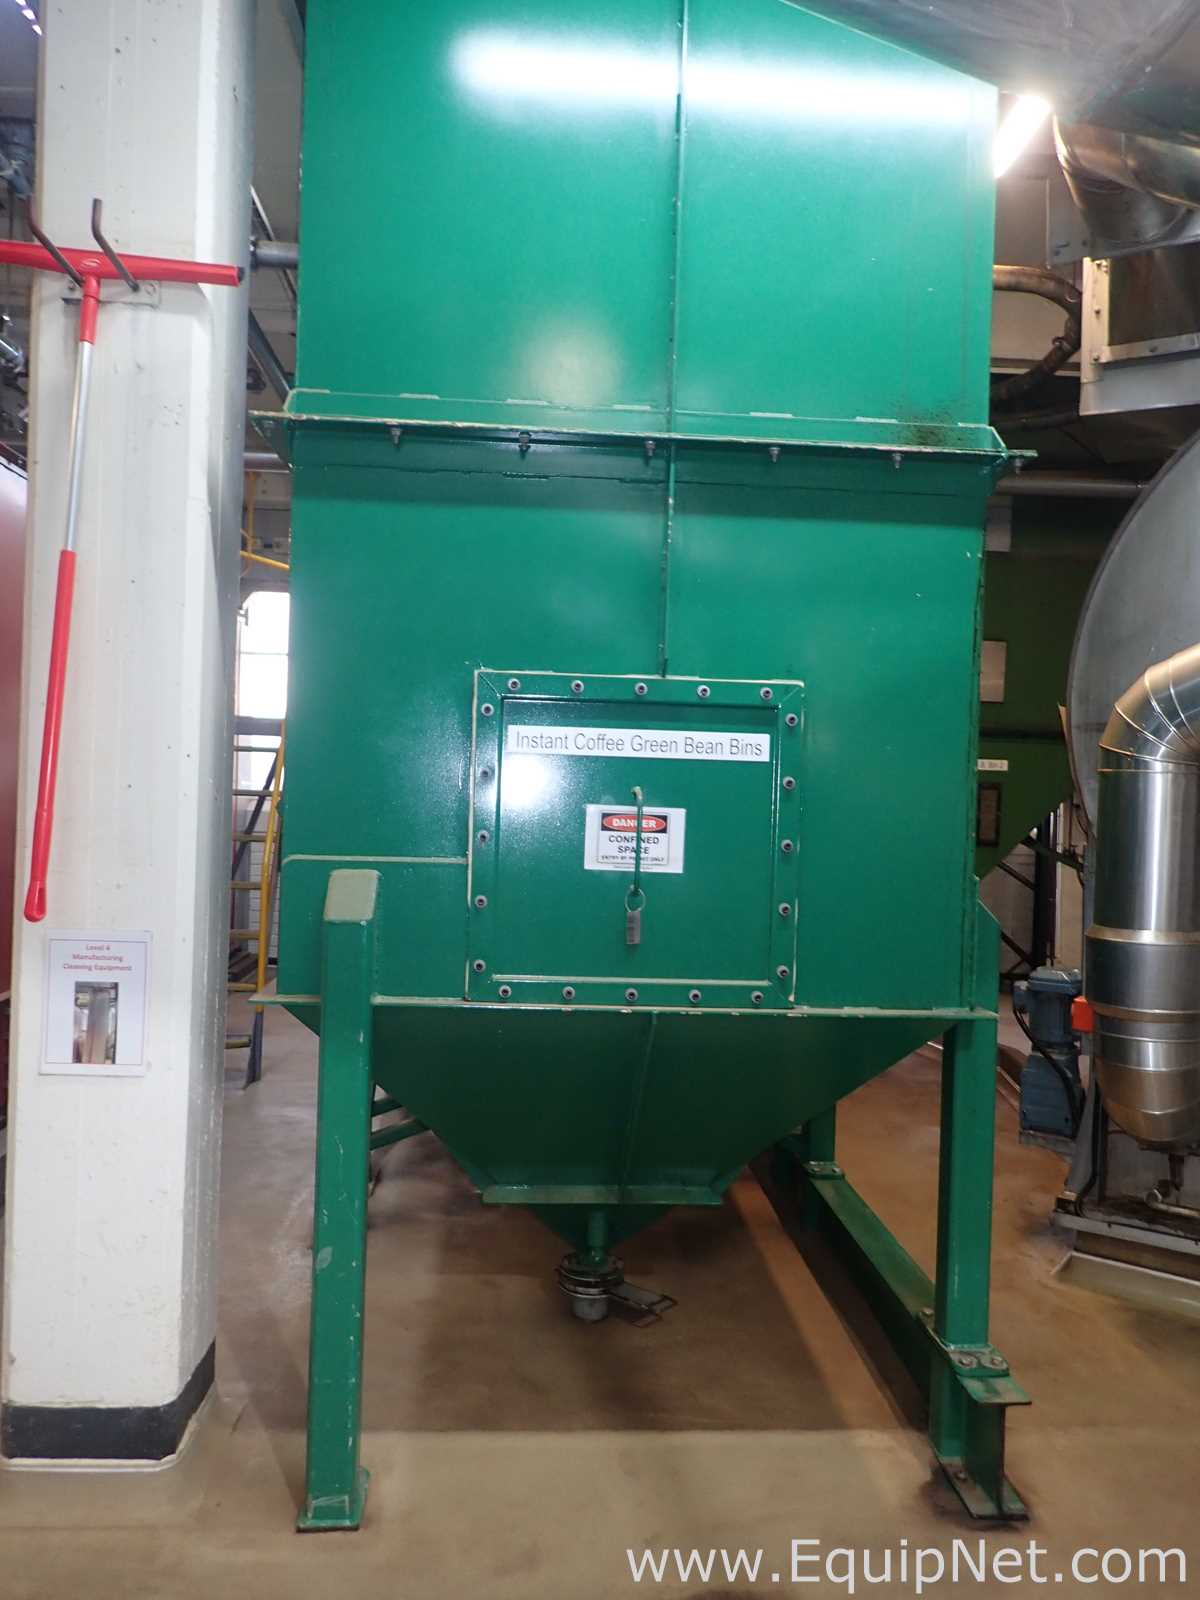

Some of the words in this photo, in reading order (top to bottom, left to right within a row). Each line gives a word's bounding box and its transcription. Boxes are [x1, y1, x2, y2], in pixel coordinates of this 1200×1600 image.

[516, 731, 569, 750] Instant
[574, 732, 625, 752] Coffee
[631, 734, 678, 753] Green
[684, 736, 724, 755] Bean
[729, 738, 762, 757] Bins
[608, 835, 659, 844] CONFNED
[72, 953, 123, 962] Manufacturing
[63, 963, 92, 971] Cleaning
[94, 963, 132, 971] Equipment
